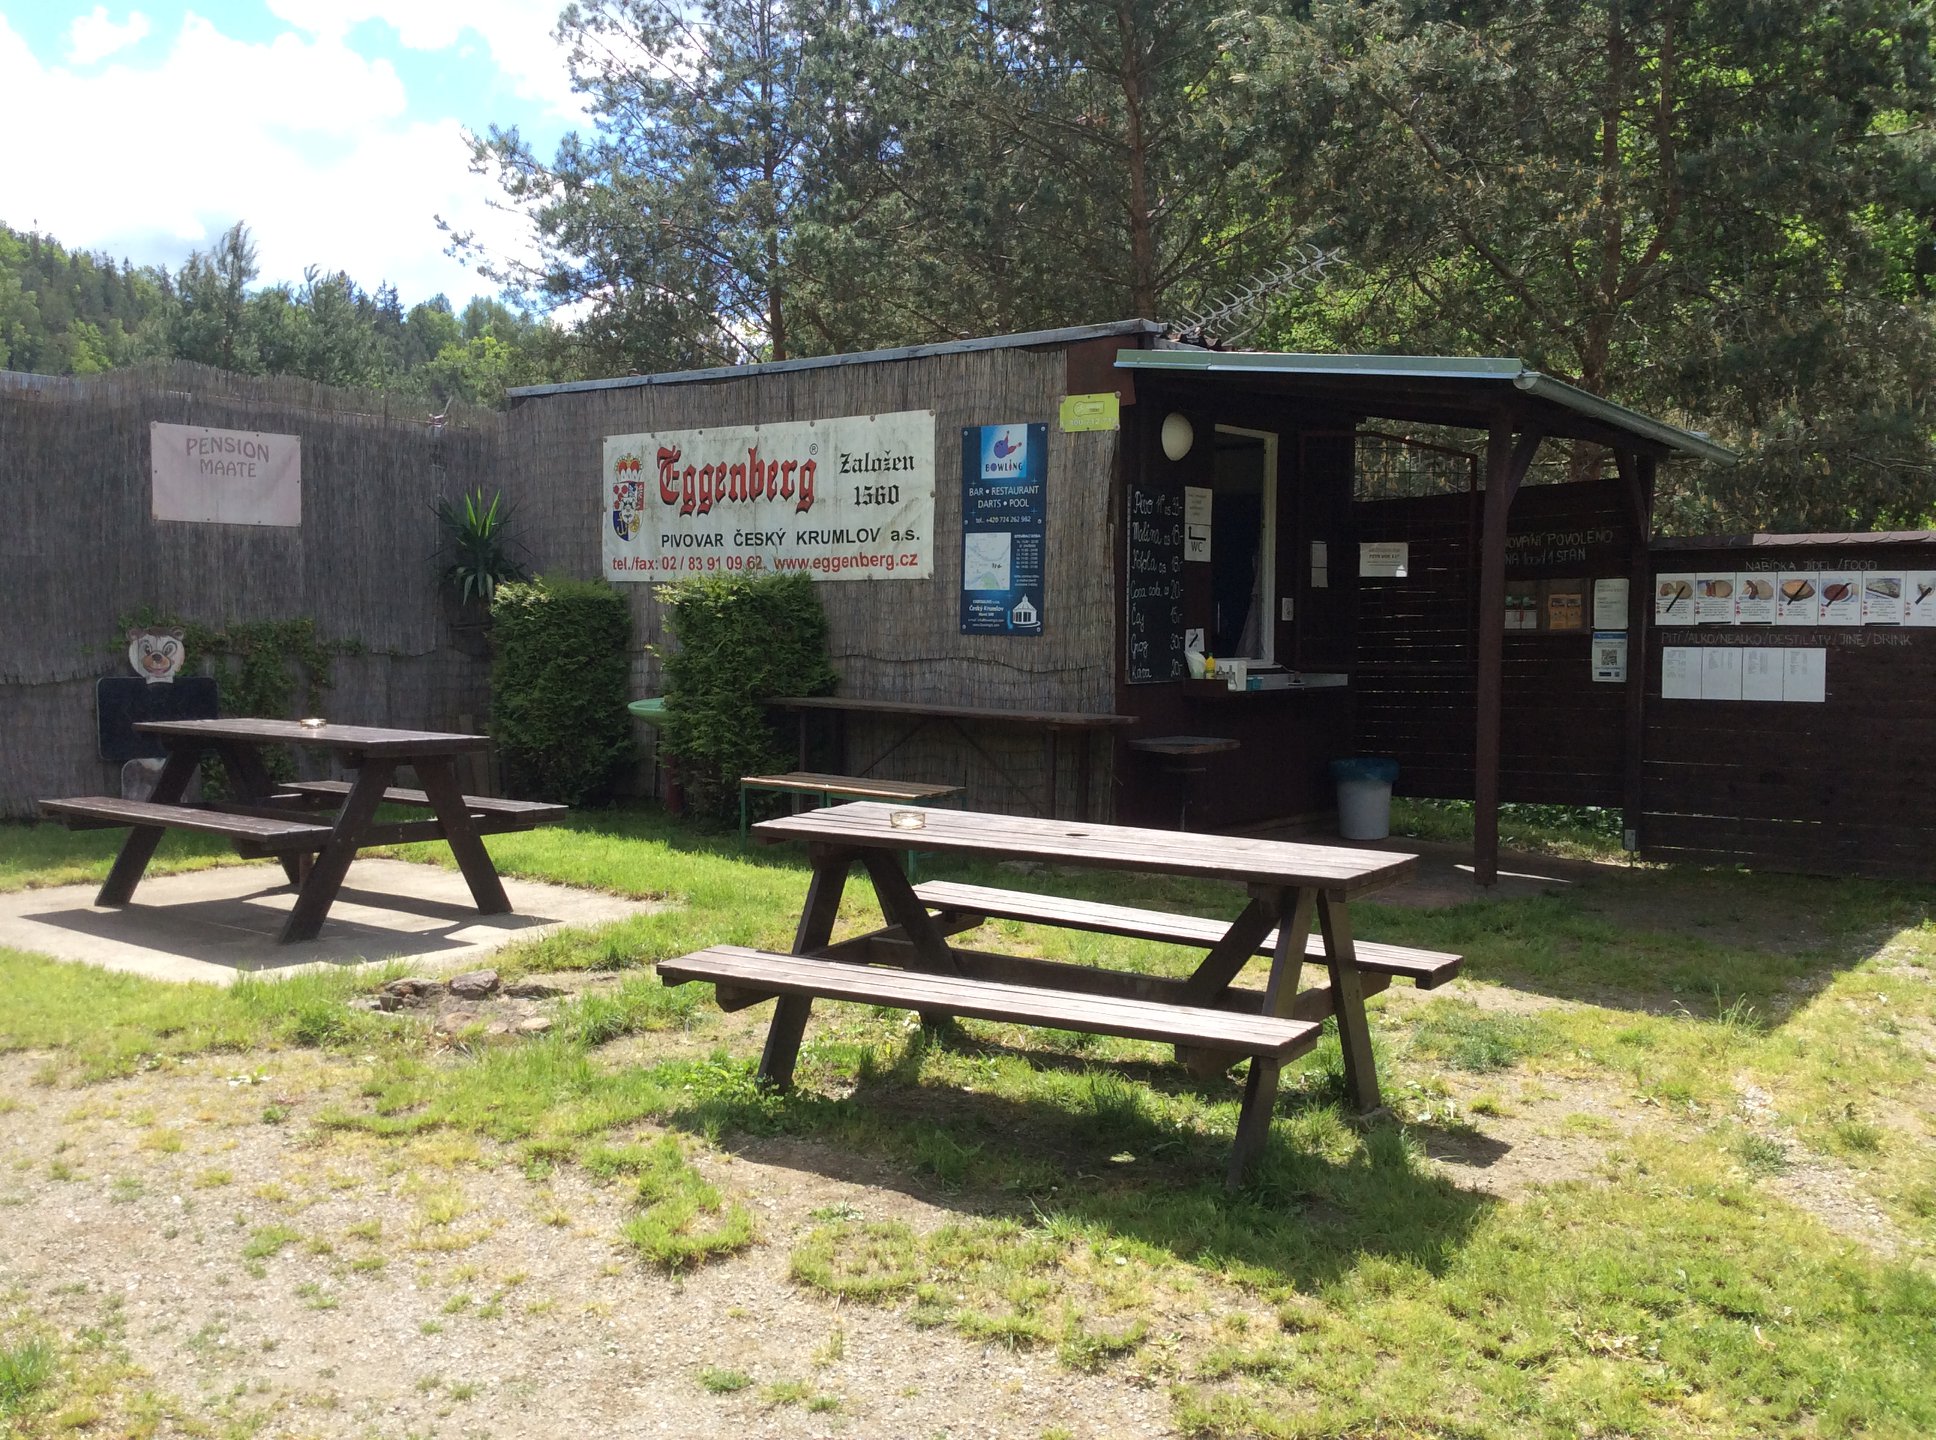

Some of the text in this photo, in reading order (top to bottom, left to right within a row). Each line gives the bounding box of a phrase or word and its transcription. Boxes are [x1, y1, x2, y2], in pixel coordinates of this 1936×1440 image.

[186, 437, 270, 463] PENSION
[200, 459, 257, 478] MAATE
[839, 450, 915, 474] Založen
[657, 445, 817, 516] Eggenberg
[854, 484, 900, 507] 1560
[969, 485, 1039, 496] BAR RESTAURANT
[978, 498, 1030, 508] DARTS POOL
[1133, 490, 1154, 515] Pivo
[661, 528, 920, 548] PIVOVAR ČESKÝ KRUMLOV a.s.
[1547, 529, 1613, 545] POVOLENO
[1190, 542, 1203, 552] WC
[1556, 547, 1586, 562] STAN
[662, 556, 677, 570] 02
[688, 557, 703, 570] 83
[707, 556, 721, 570] 91
[726, 556, 743, 570] 09
[774, 552, 918, 573] www.eggenberg.cz
[1745, 558, 1796, 571] NABÍDKA
